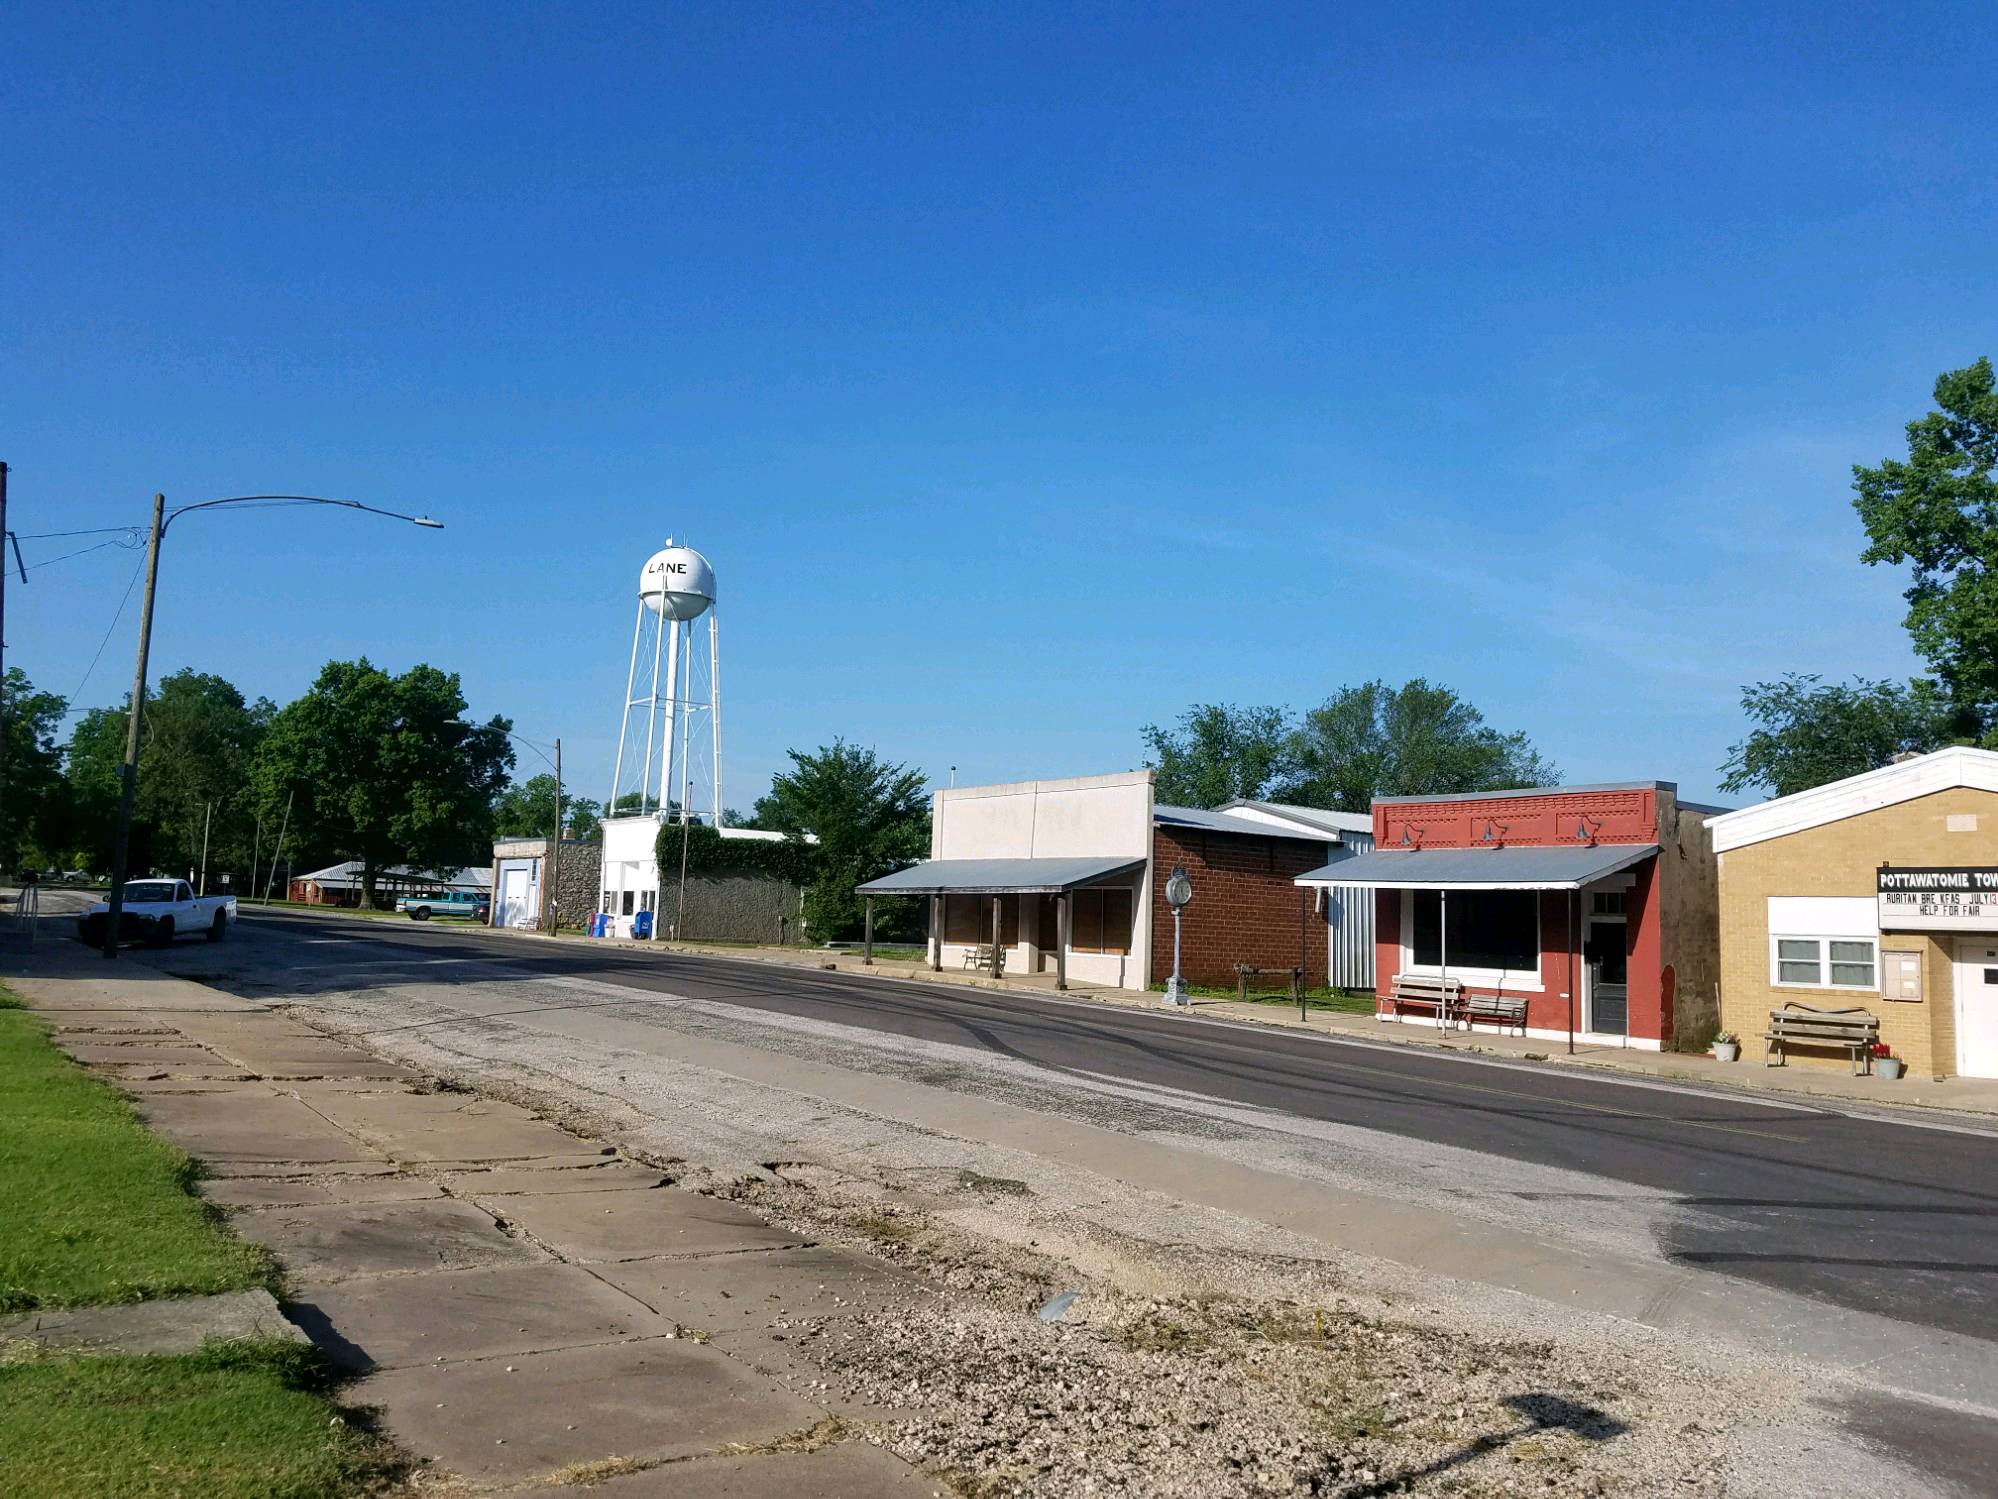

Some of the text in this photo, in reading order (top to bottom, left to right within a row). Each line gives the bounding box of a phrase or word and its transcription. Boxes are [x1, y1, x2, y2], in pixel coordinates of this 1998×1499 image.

[648, 563, 687, 574] LANE
[1880, 873, 1969, 887] POTTAWATOMIE
[1886, 893, 1917, 904] RURITAN
[1969, 893, 1988, 904] JULY
[1919, 905, 1980, 916] HELP FOR FAIR
